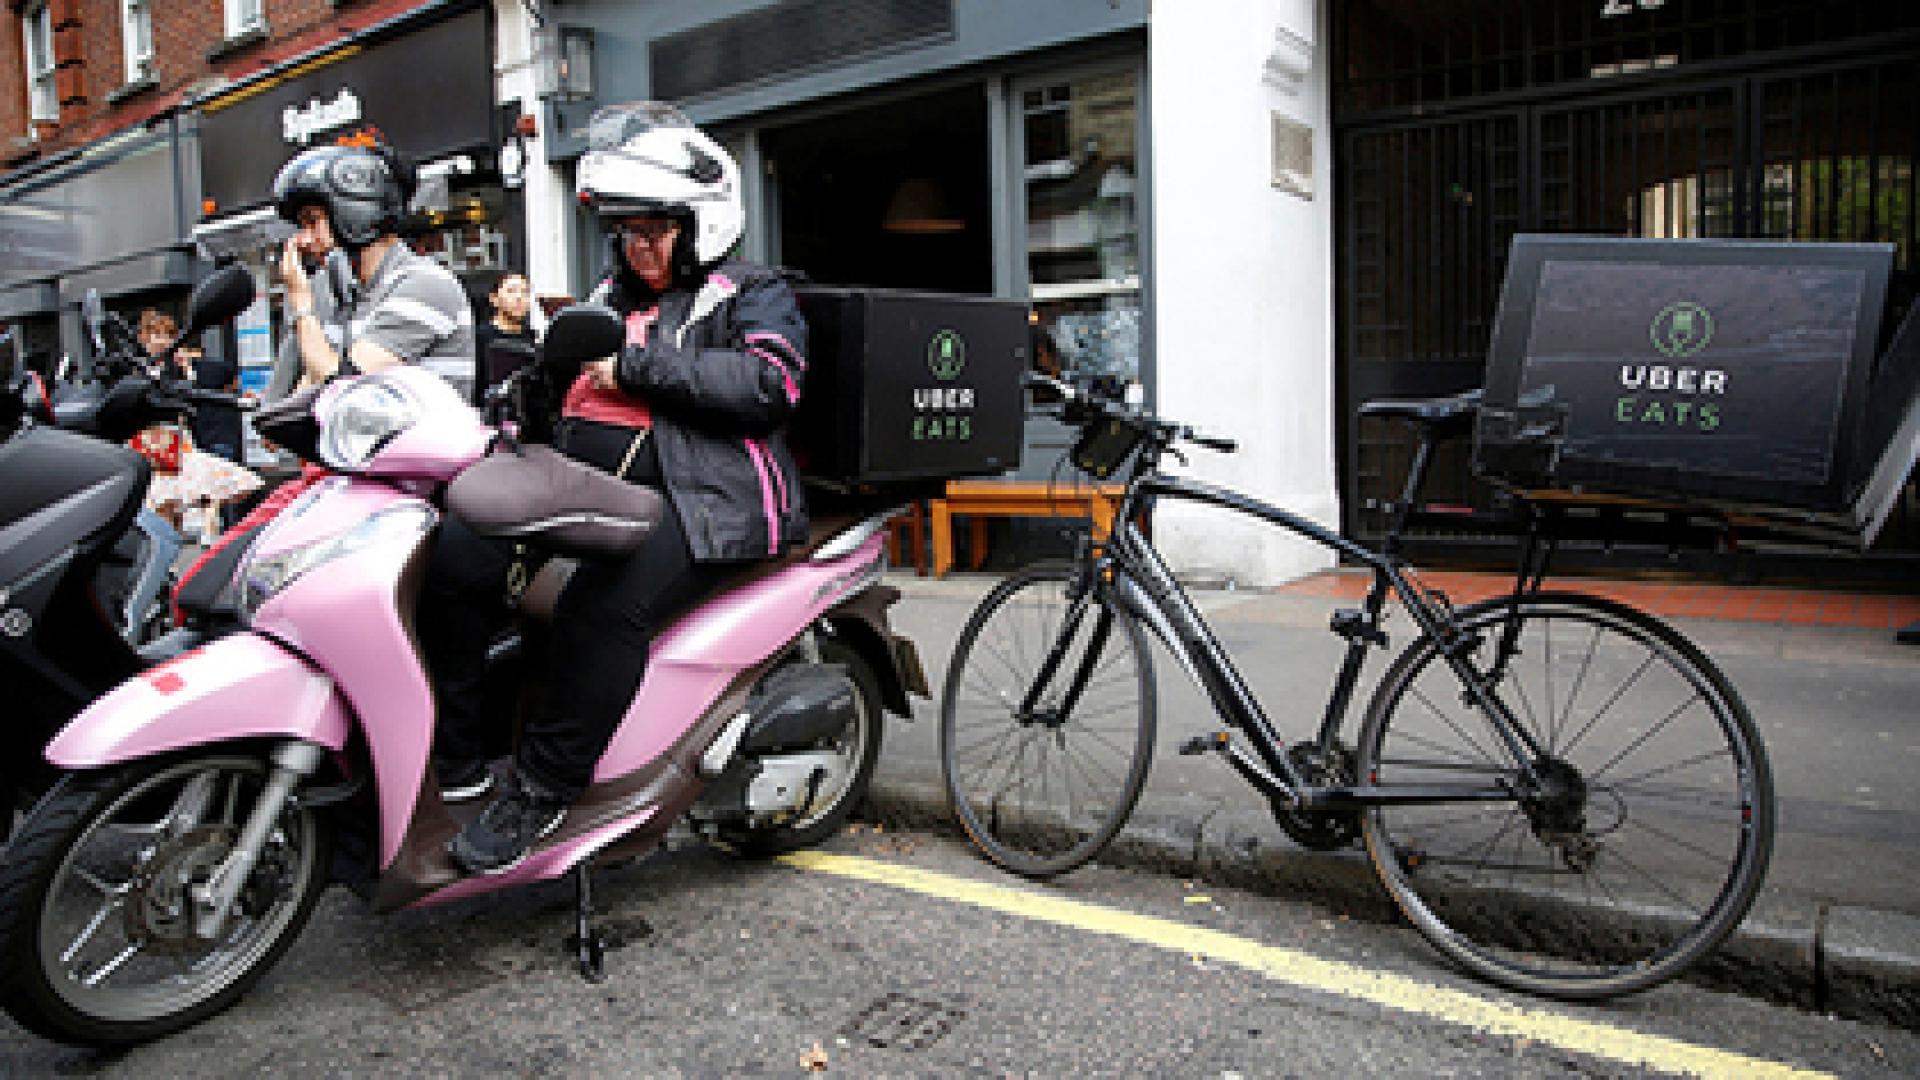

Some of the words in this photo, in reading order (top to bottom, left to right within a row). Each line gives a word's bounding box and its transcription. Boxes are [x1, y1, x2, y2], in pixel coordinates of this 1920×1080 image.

[1622, 365, 1728, 394] UBER
[913, 388, 975, 410] UBER
[1618, 398, 1720, 431] EATS
[913, 416, 971, 440] EATS
